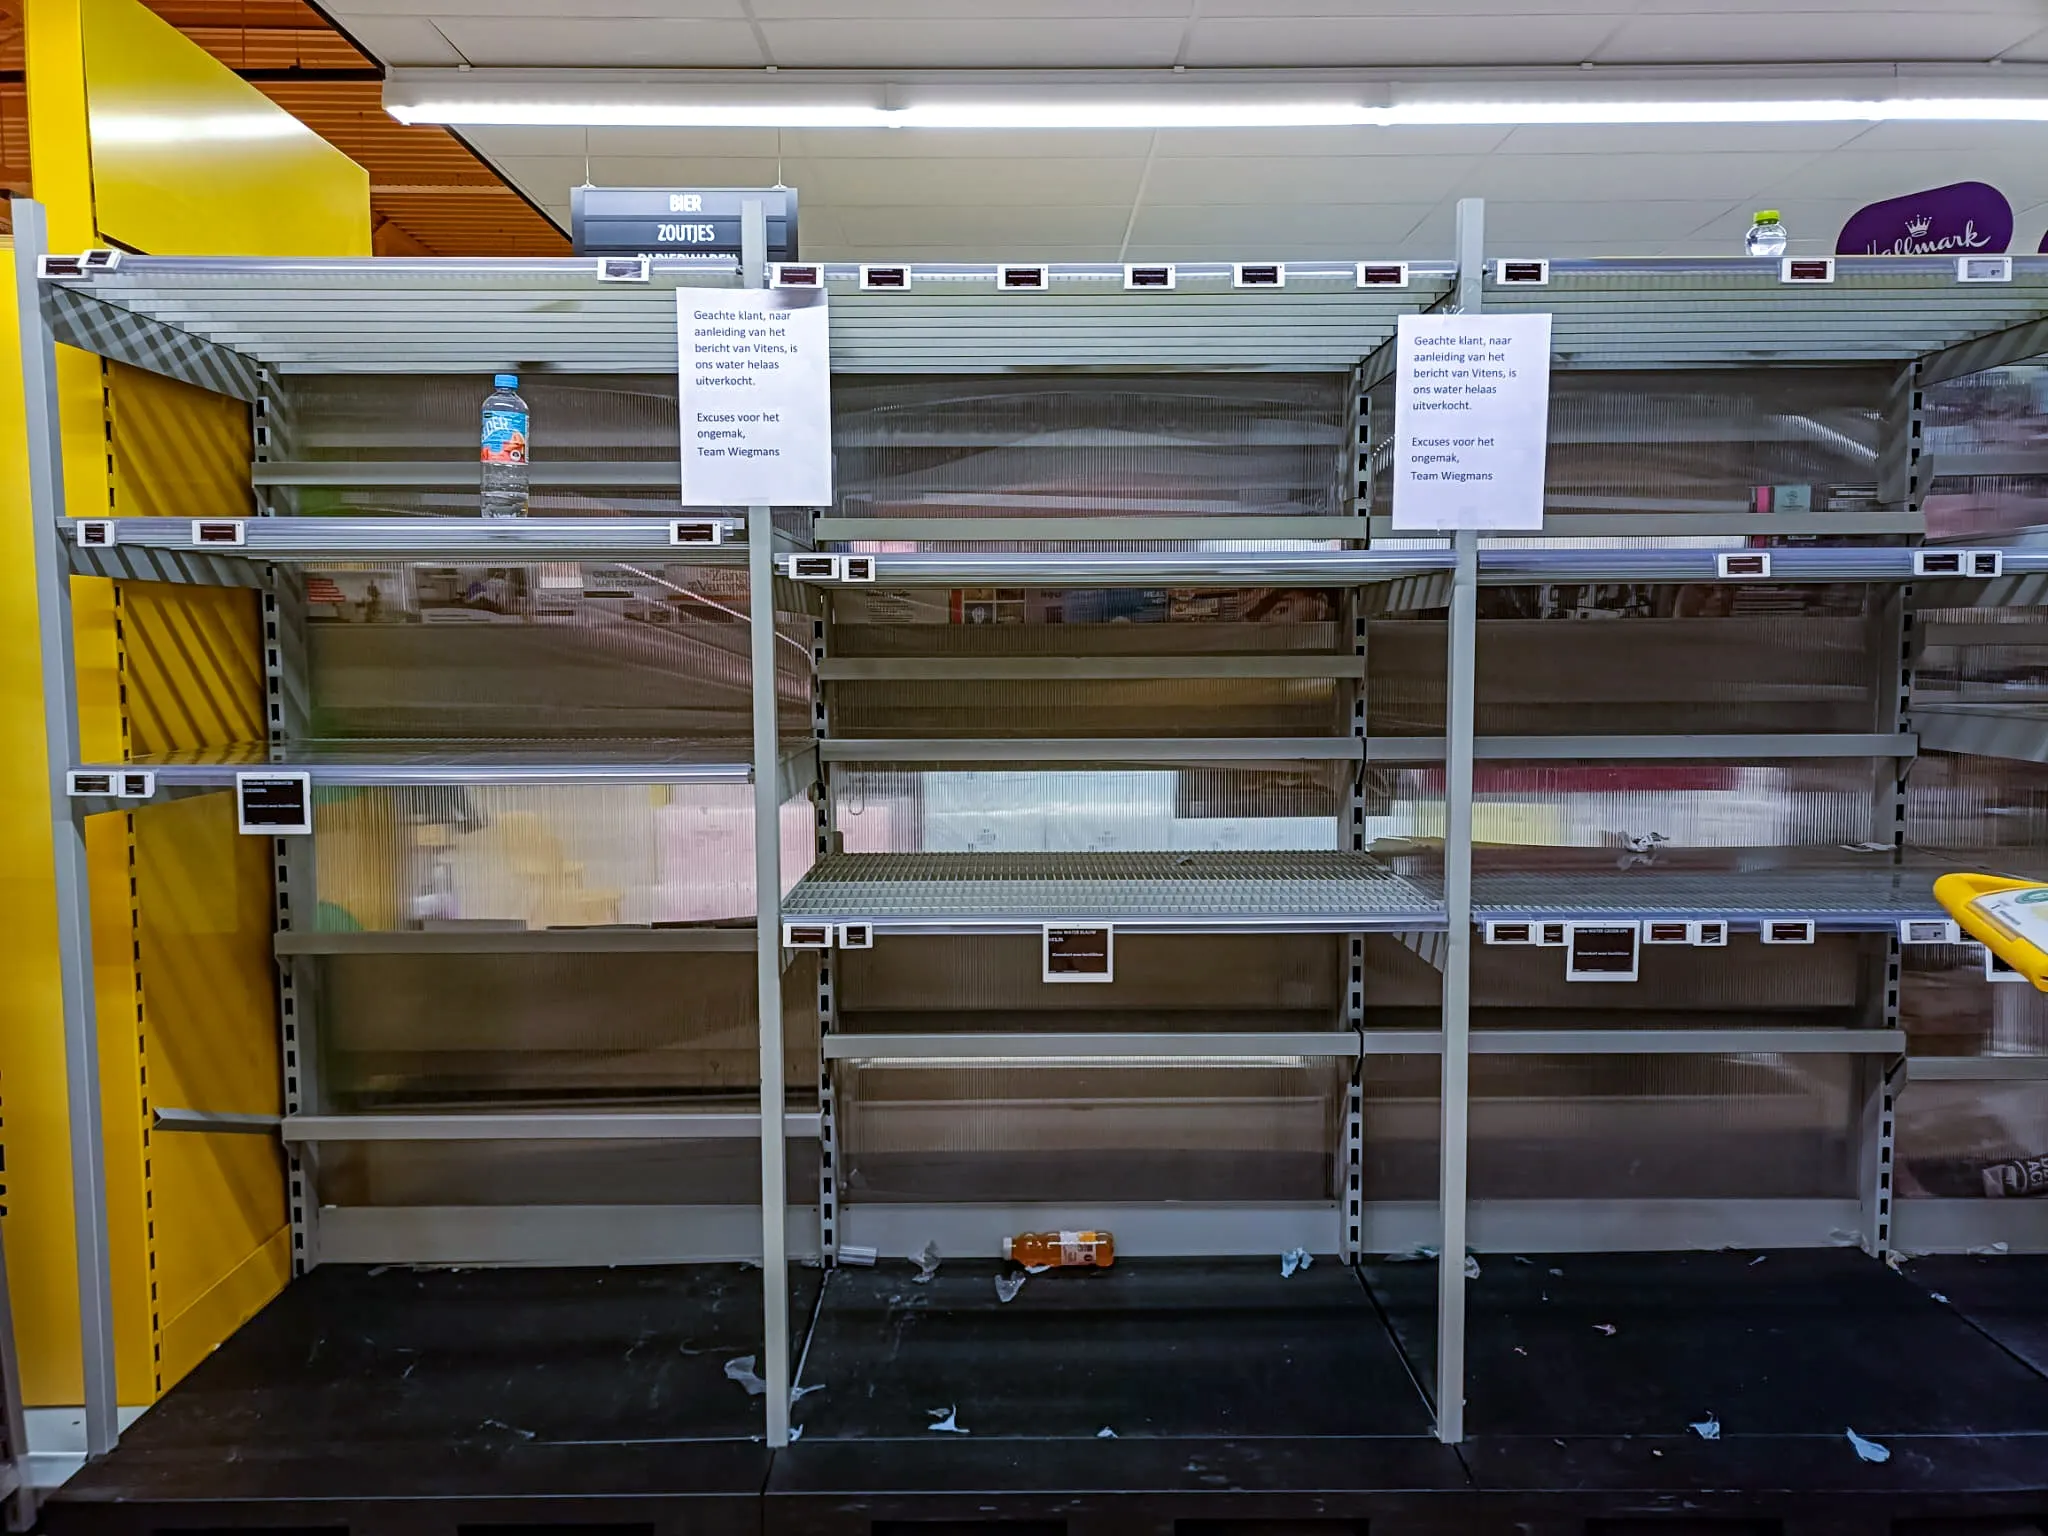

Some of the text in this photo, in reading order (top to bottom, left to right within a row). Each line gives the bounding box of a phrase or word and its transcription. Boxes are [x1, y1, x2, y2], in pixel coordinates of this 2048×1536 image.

[669, 194, 702, 212] BIER
[657, 224, 715, 244] ZOUTJES
[694, 311, 791, 321] Geachte klant, naar
[695, 327, 746, 338] aanleiding
[769, 328, 785, 336] het
[1414, 336, 1512, 346] Geachte klant, naar
[695, 344, 798, 353] bericht van Vitens, is
[1414, 352, 1464, 363] aanleiding
[1489, 353, 1504, 361] het
[696, 360, 779, 369] ons water helaas
[1414, 369, 1516, 378] bericht van Vitens, is
[696, 376, 755, 385] uitverkocht.
[1413, 385, 1497, 394] ons water helaas
[1413, 401, 1472, 410] uitverkocht.
[697, 413, 779, 422] Excuses voor het
[697, 429, 745, 439] ongemak,
[1412, 438, 1494, 447] Excuses voor het
[697, 447, 780, 457] Team Wiegmans
[1412, 454, 1460, 464] ongemak,
[1411, 472, 1493, 482] Team Wiegmans
